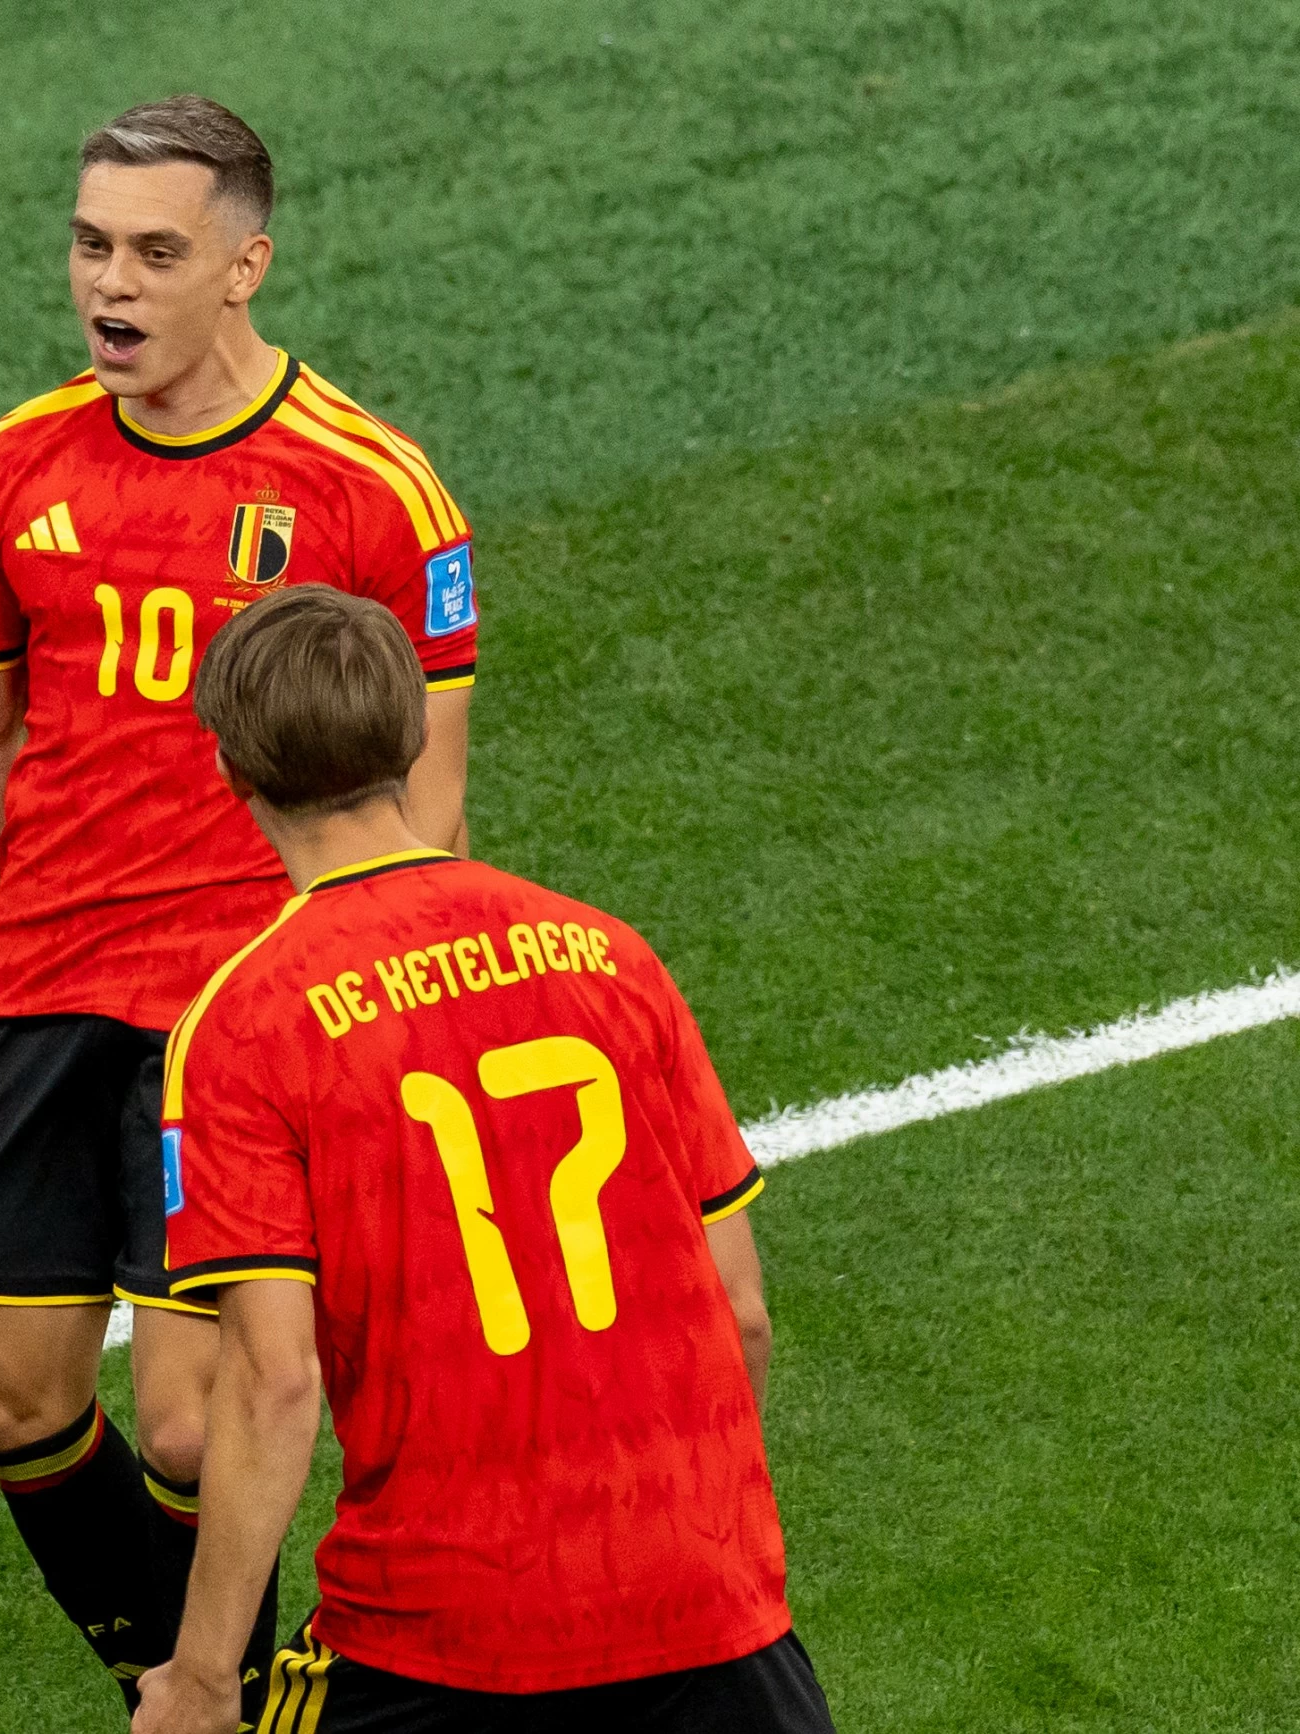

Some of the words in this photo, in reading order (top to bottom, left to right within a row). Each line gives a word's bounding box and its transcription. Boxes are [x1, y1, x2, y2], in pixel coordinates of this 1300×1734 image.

[265, 507, 286, 515] ROYAL
[93, 582, 195, 703] 10
[305, 970, 379, 1039] DE
[373, 920, 618, 1013] KETELAERE
[400, 1035, 627, 1356] 17
